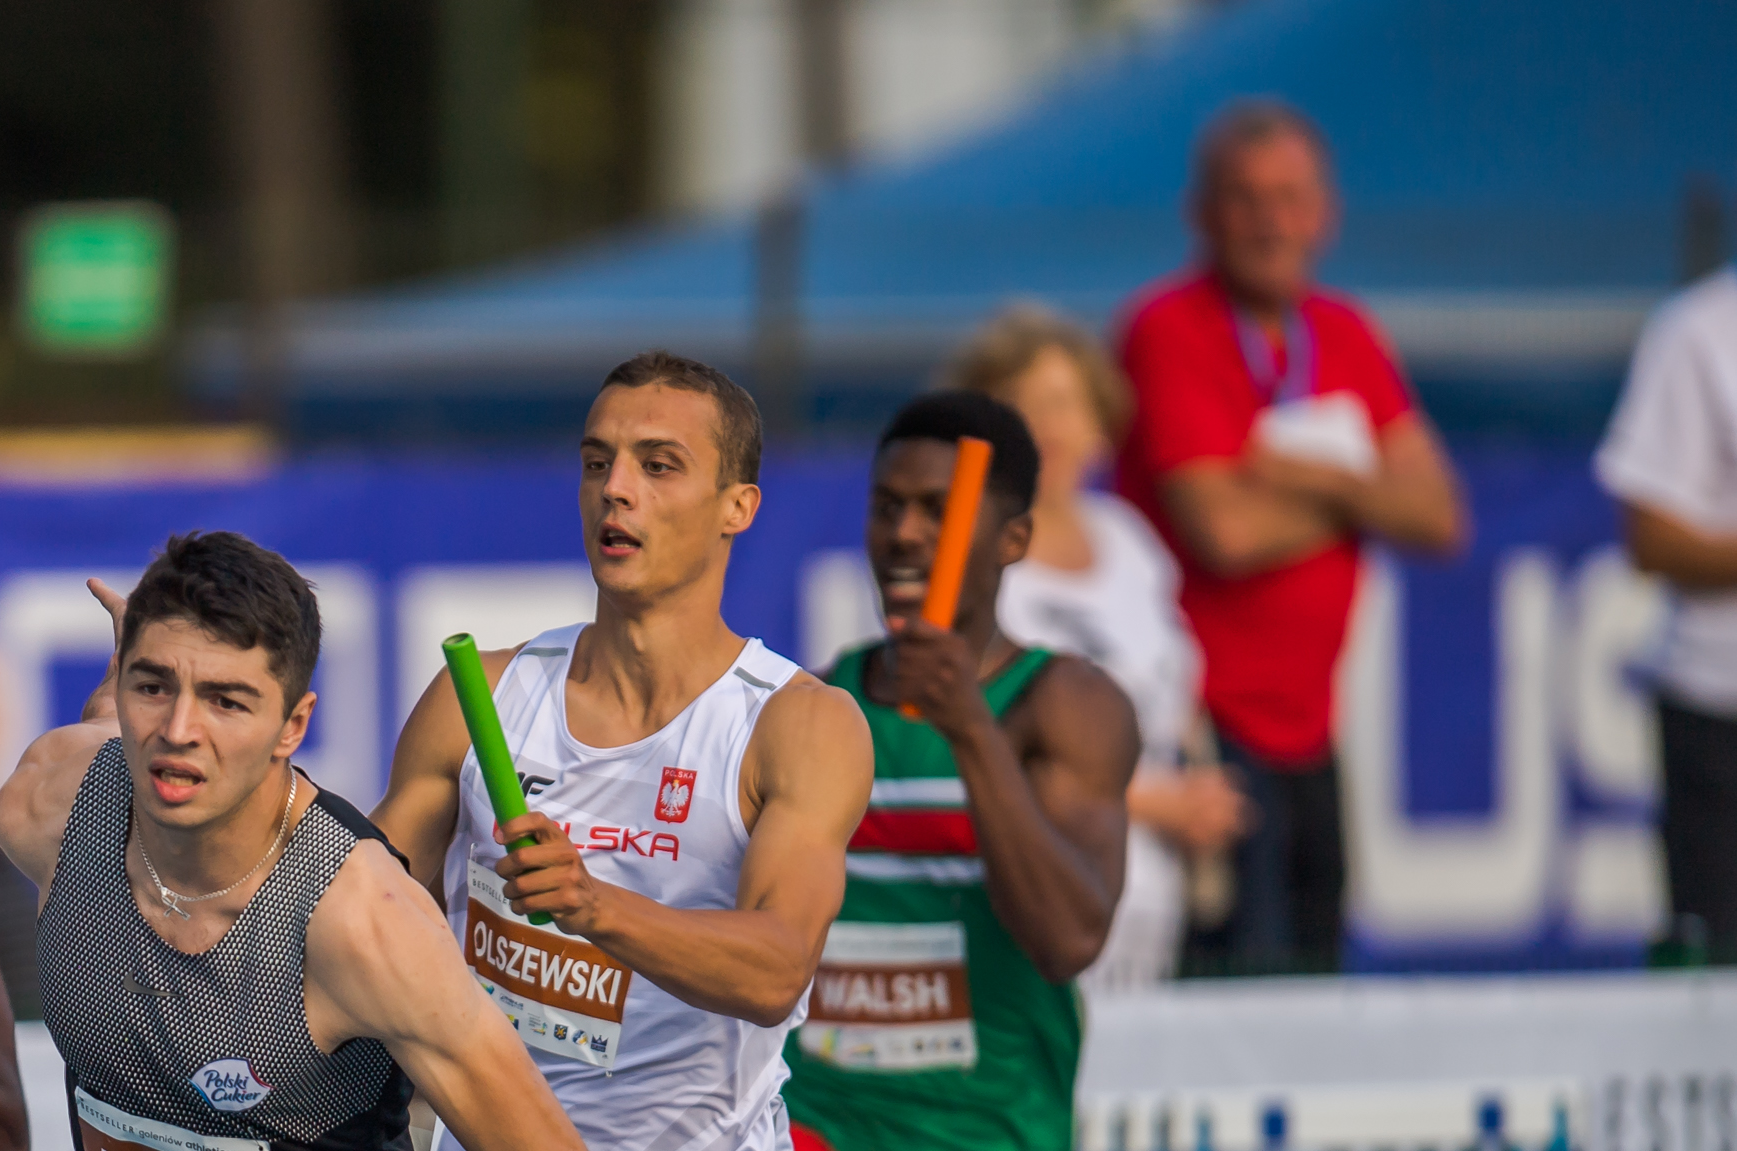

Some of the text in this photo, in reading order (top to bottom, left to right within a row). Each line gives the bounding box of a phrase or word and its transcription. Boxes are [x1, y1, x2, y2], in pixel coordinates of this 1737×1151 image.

[664, 769, 694, 780] POLSKA
[493, 818, 680, 862] LSKA
[473, 919, 623, 1006] OLSZEWSKI
[816, 970, 953, 1017] WALSH
[204, 1069, 249, 1089] Polski
[210, 1087, 262, 1104] Cukier
[80, 1101, 135, 1135] BESTSELLER
[138, 1128, 183, 1147] goleniów
